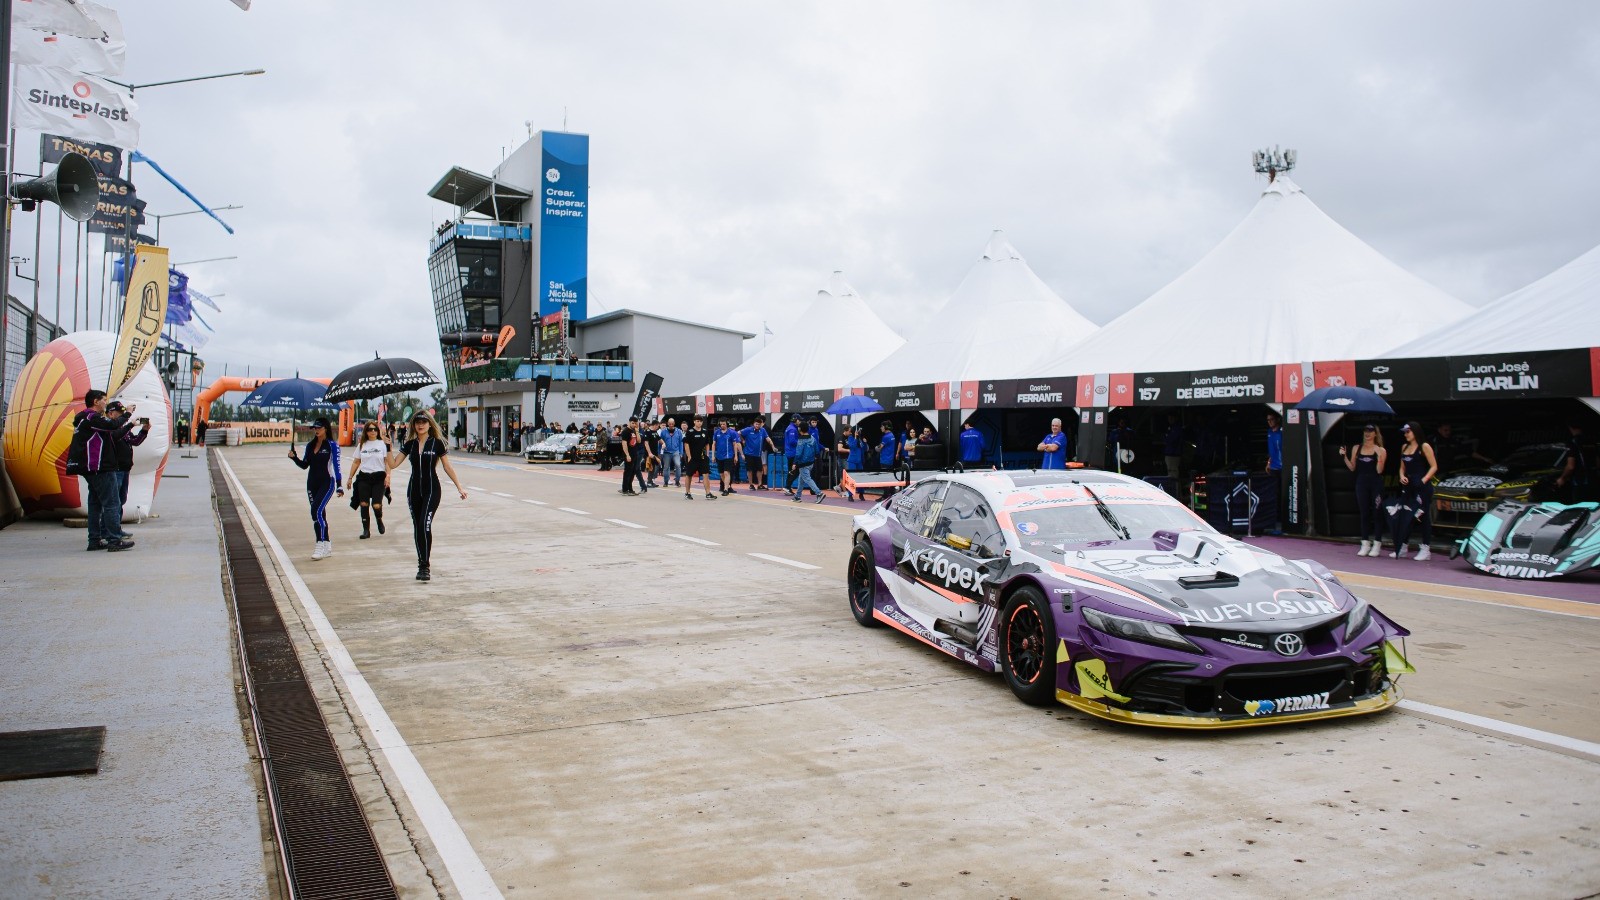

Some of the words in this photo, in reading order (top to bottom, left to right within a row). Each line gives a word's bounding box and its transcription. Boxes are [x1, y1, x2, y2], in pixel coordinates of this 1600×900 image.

[28, 88, 129, 122] Sinteplast
[546, 188, 575, 197] Crear.
[546, 198, 586, 208] Superar.
[546, 208, 584, 218] Inspirar.
[549, 281, 565, 291] San
[548, 289, 577, 298] Nicolás
[1464, 364, 1496, 374] Juan
[1498, 361, 1530, 373] José
[358, 374, 391, 383] FISPA
[1191, 377, 1211, 386] Juan
[1212, 374, 1248, 385] Bautista
[1029, 384, 1051, 392] Gastón
[1176, 387, 1193, 400] DE
[1193, 384, 1265, 399] BENEDICTIS
[1370, 378, 1394, 395] 13
[1017, 392, 1062, 404] FERRANTE
[1138, 387, 1160, 401] 157
[784, 401, 789, 409] 2
[895, 398, 920, 407] AGRELO
[1490, 552, 1529, 560] GRUPO
[1531, 553, 1559, 565] GEN
[1275, 691, 1330, 712] VERMAZ
